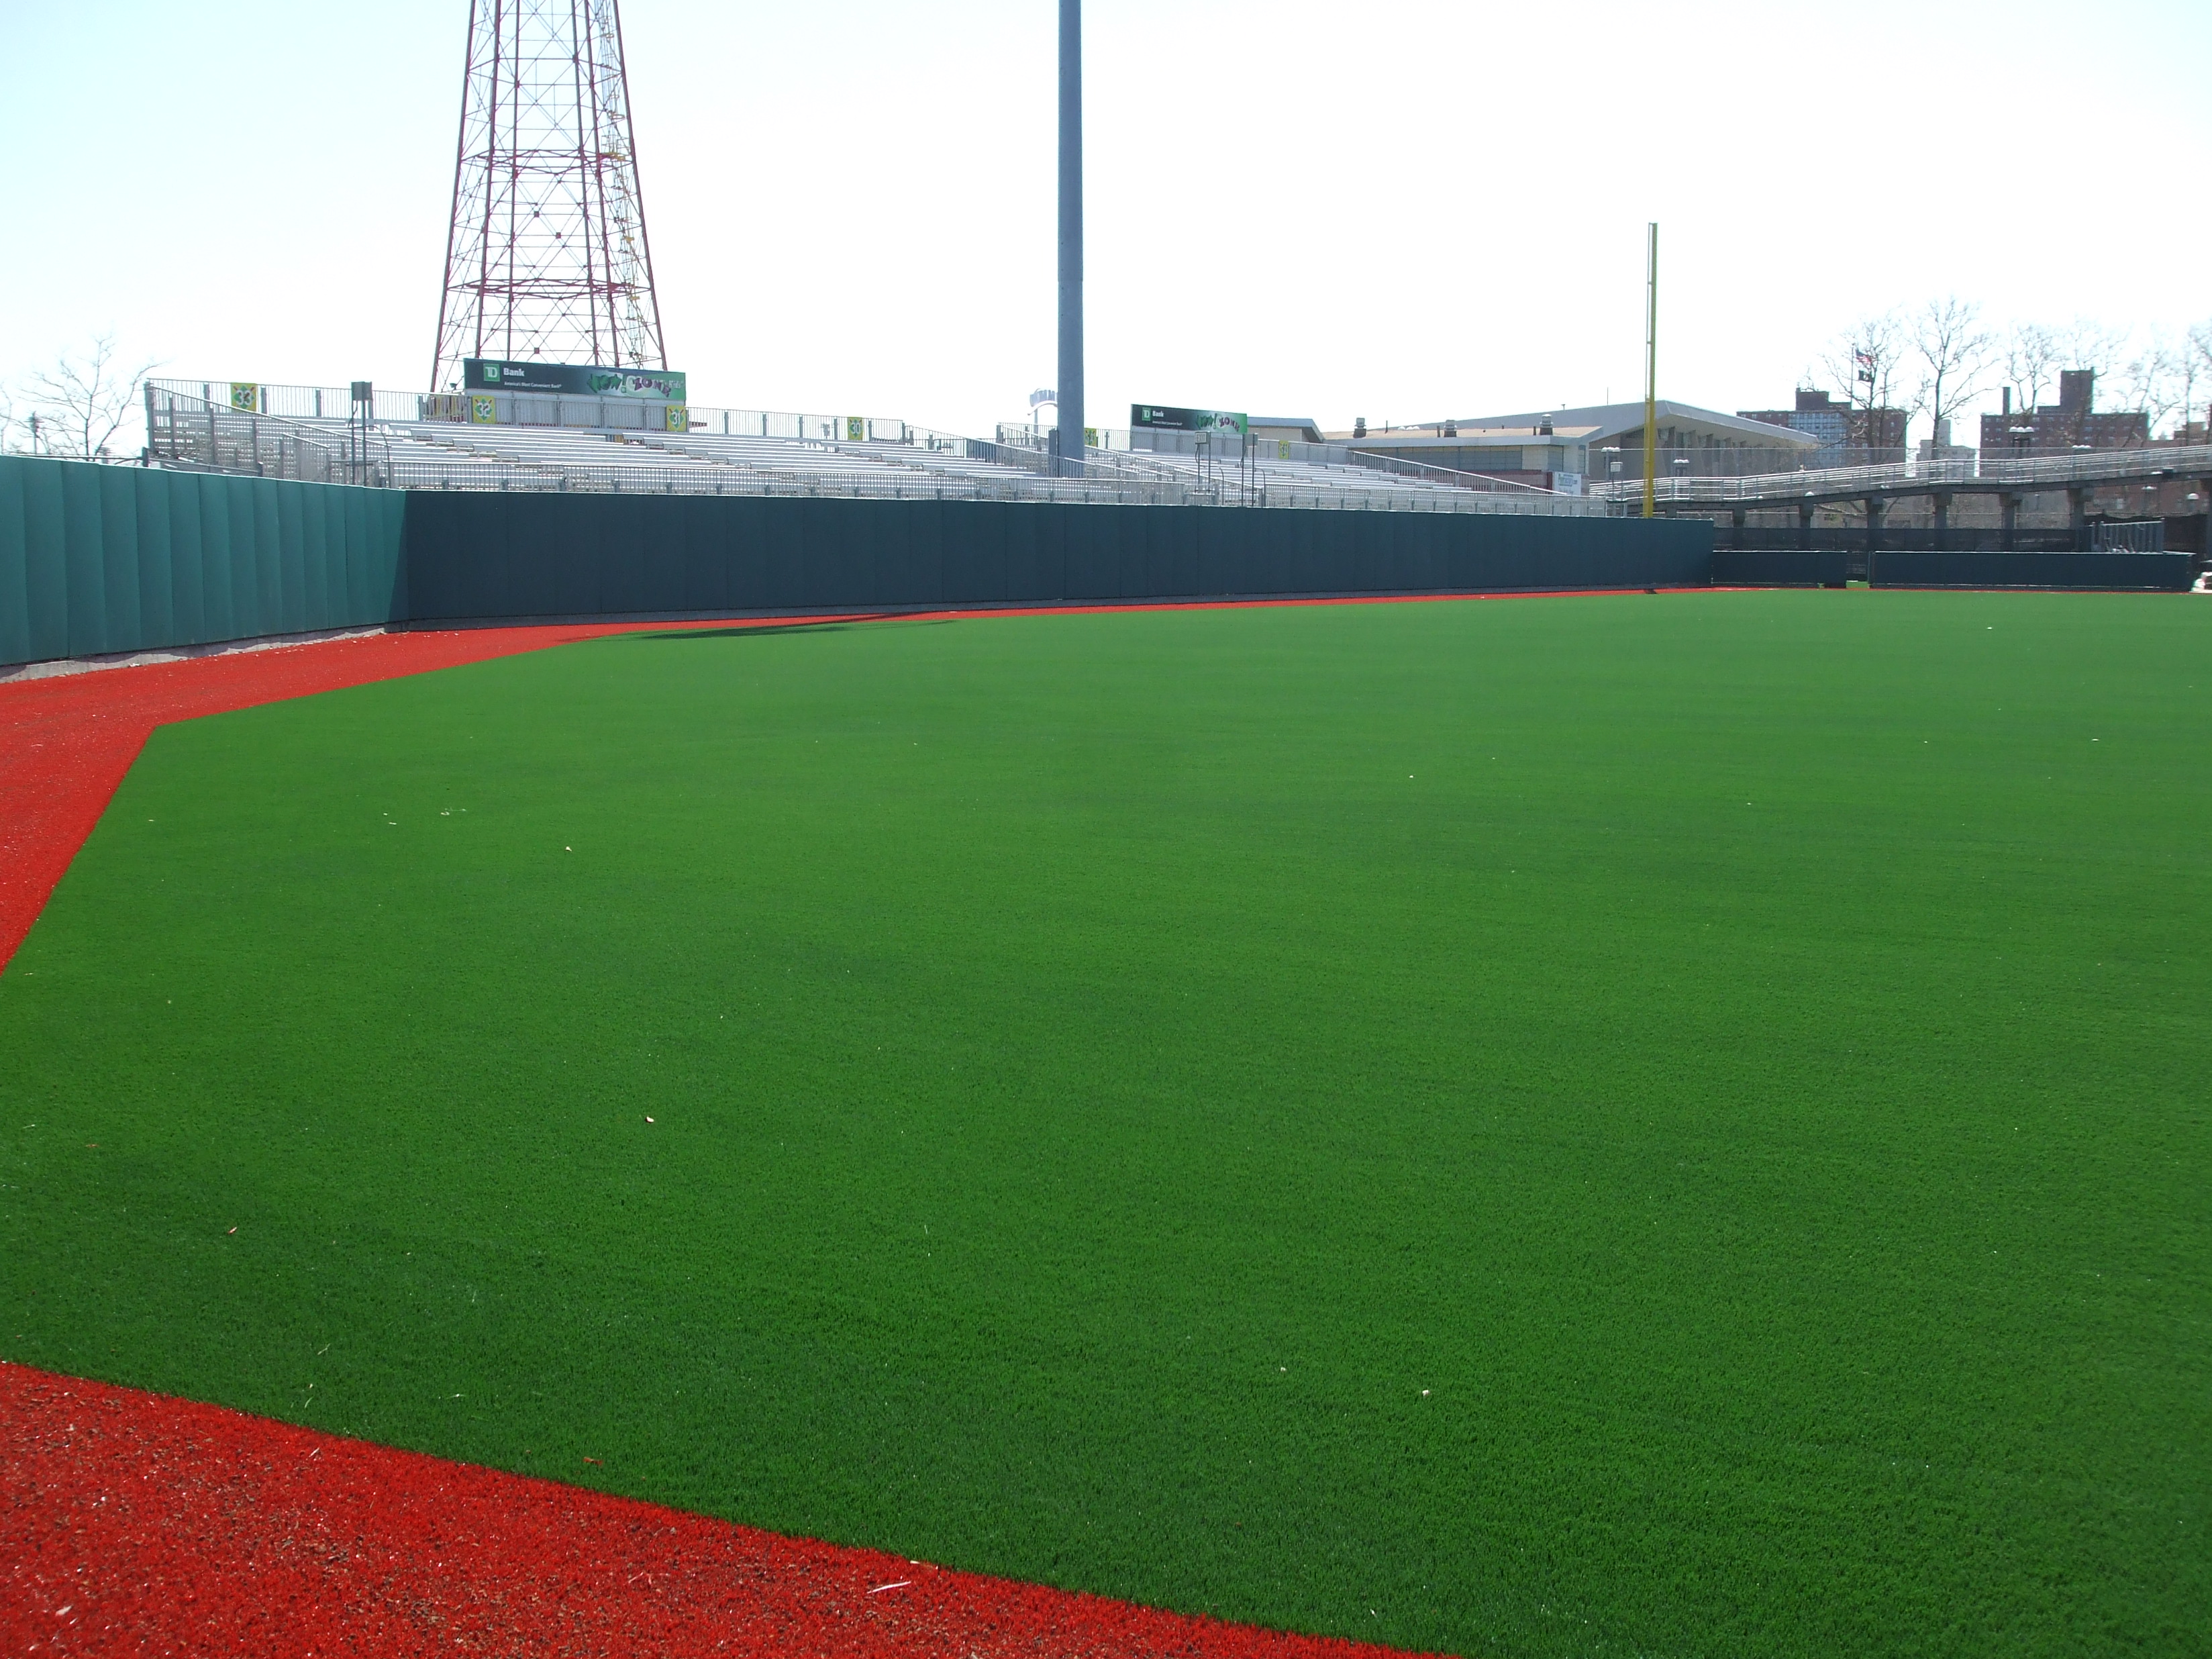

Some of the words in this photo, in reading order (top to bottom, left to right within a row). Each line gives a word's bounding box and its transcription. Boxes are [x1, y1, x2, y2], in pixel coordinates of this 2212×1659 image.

[485, 366, 497, 378] TD
[503, 368, 525, 376] Bank
[236, 390, 251, 405] 33
[478, 403, 491, 417] 32
[672, 411, 681, 425] 31
[851, 422, 860, 434] 30
